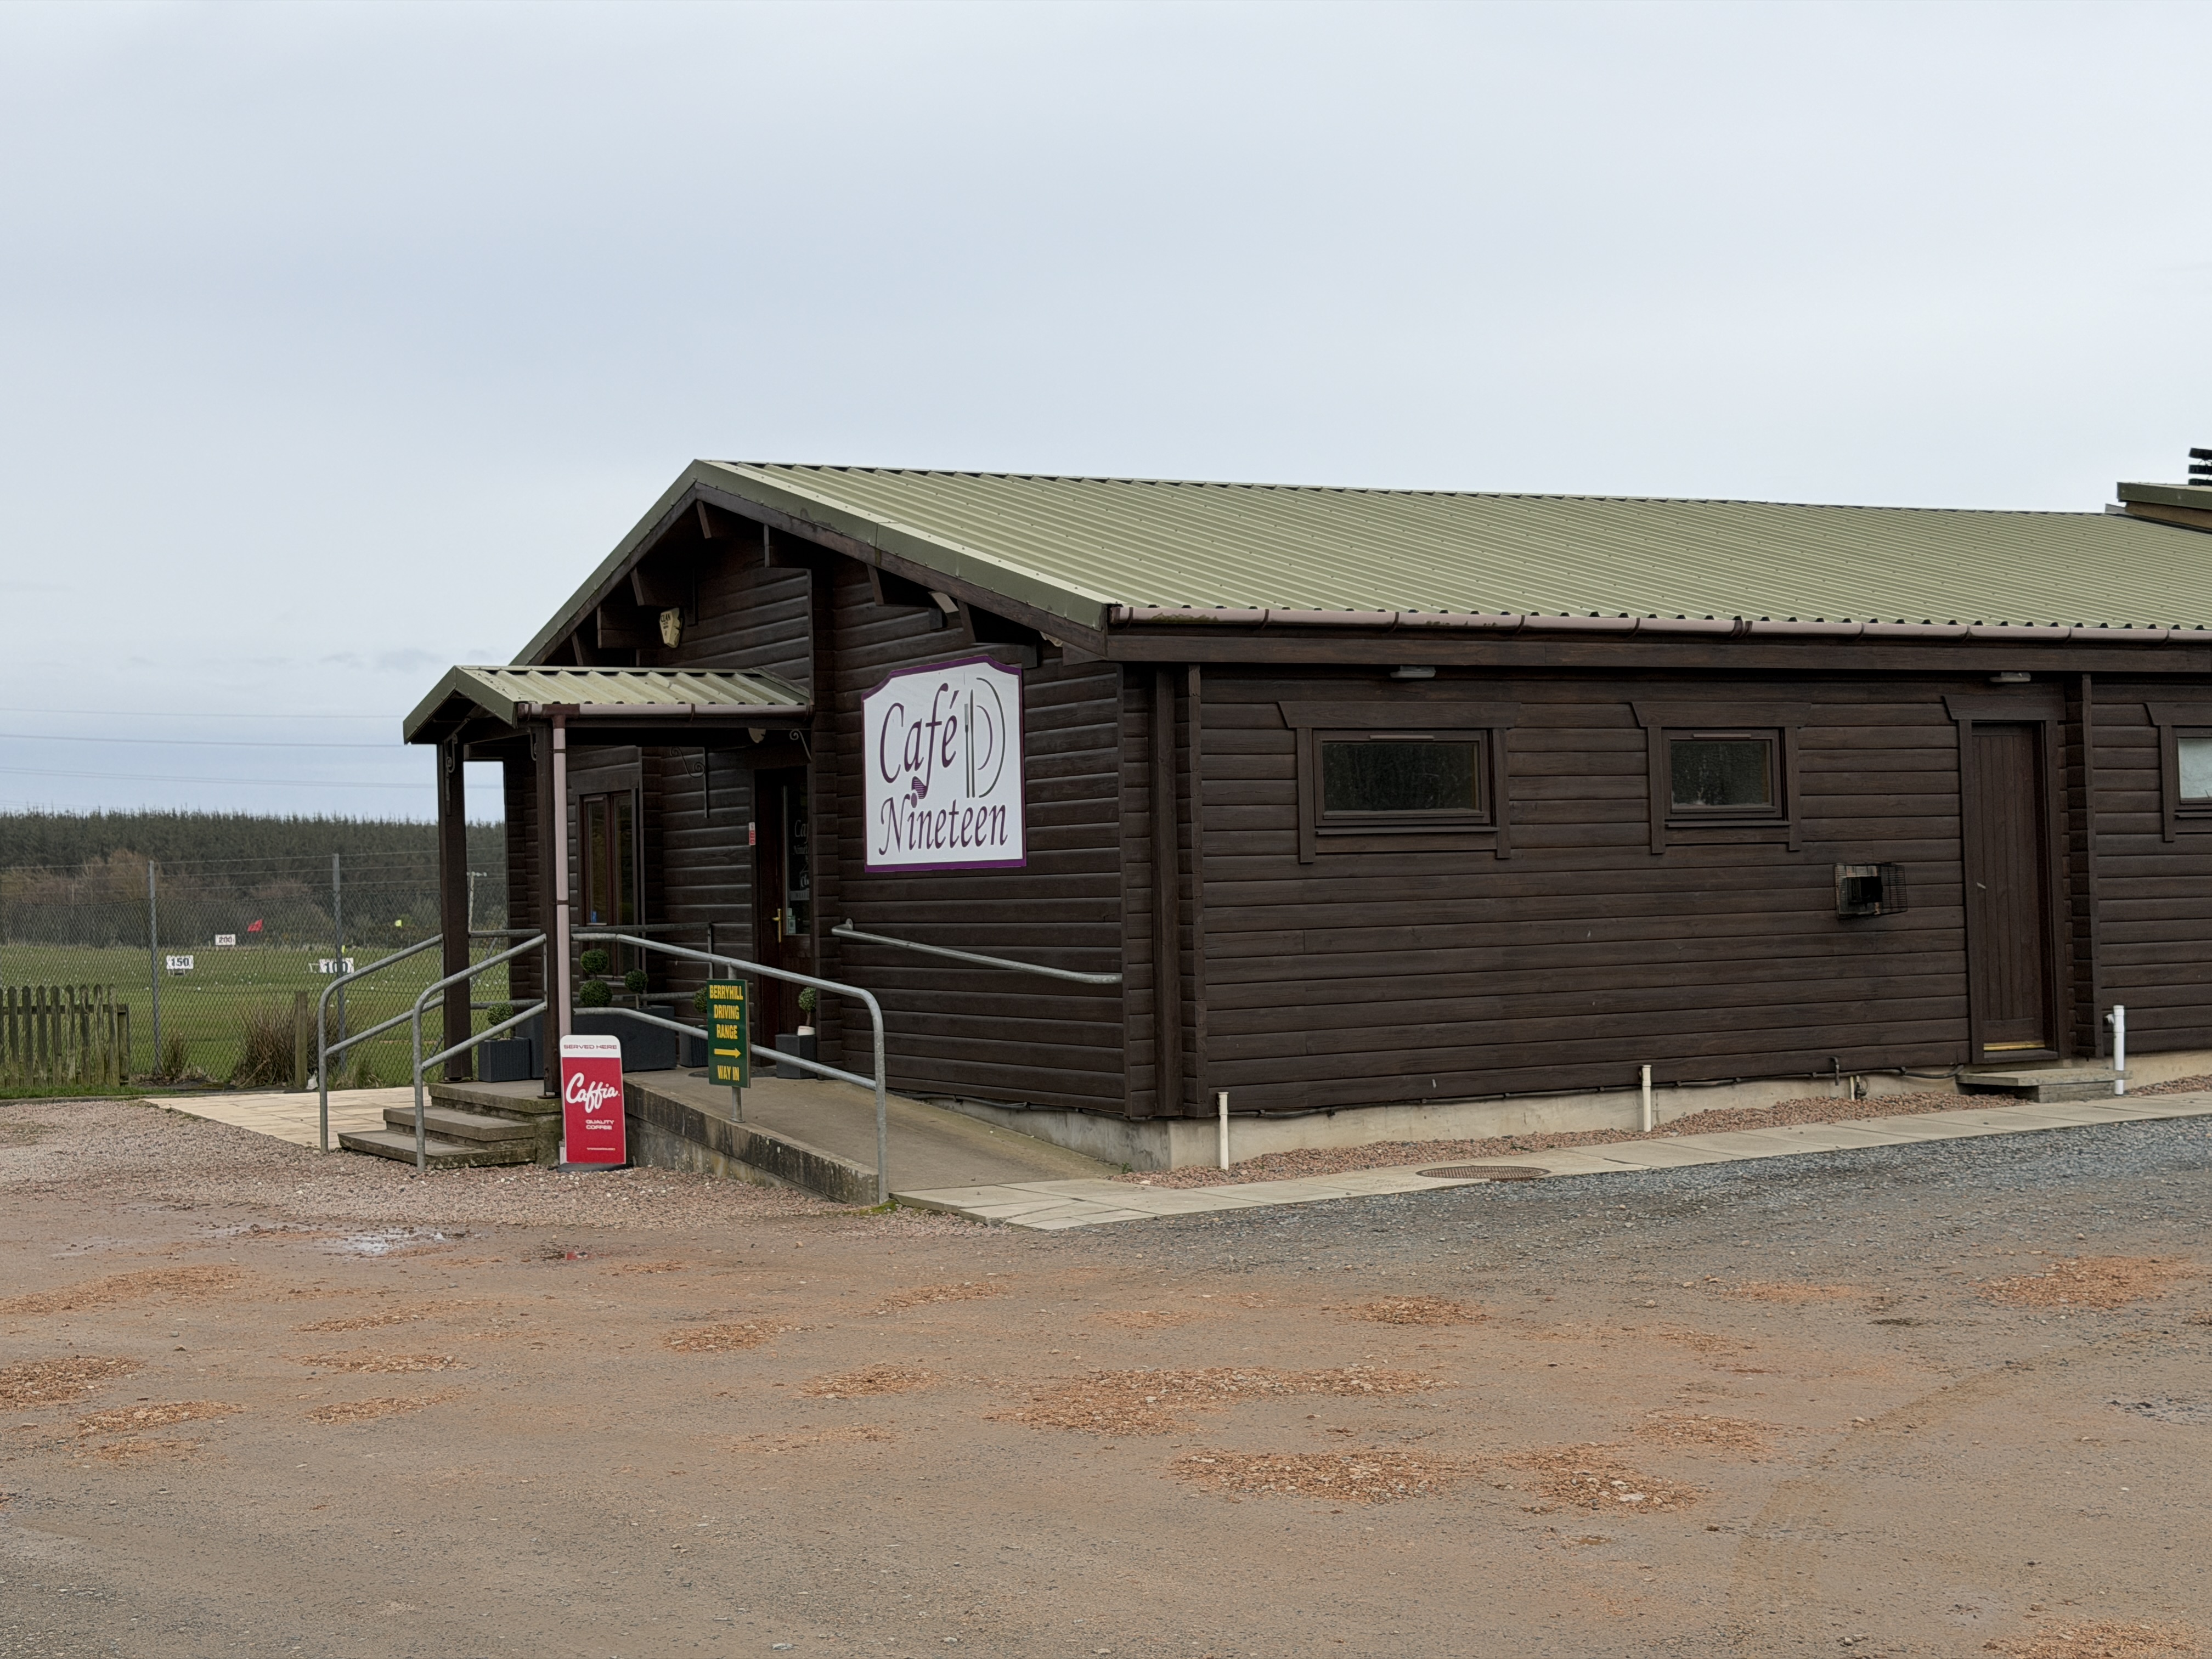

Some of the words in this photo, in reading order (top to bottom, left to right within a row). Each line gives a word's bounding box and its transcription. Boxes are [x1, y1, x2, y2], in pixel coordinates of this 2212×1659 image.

[879, 682, 960, 799] Café
[878, 793, 1008, 856] Nineteen
[171, 957, 190, 967] 150
[709, 984, 744, 1000] BERRYHILL
[713, 1004, 740, 1020] DRIVING
[716, 1024, 738, 1040] RANGE
[717, 1065, 731, 1081] WAY
[732, 1066, 740, 1081] IN
[566, 1072, 619, 1114] Caffia
